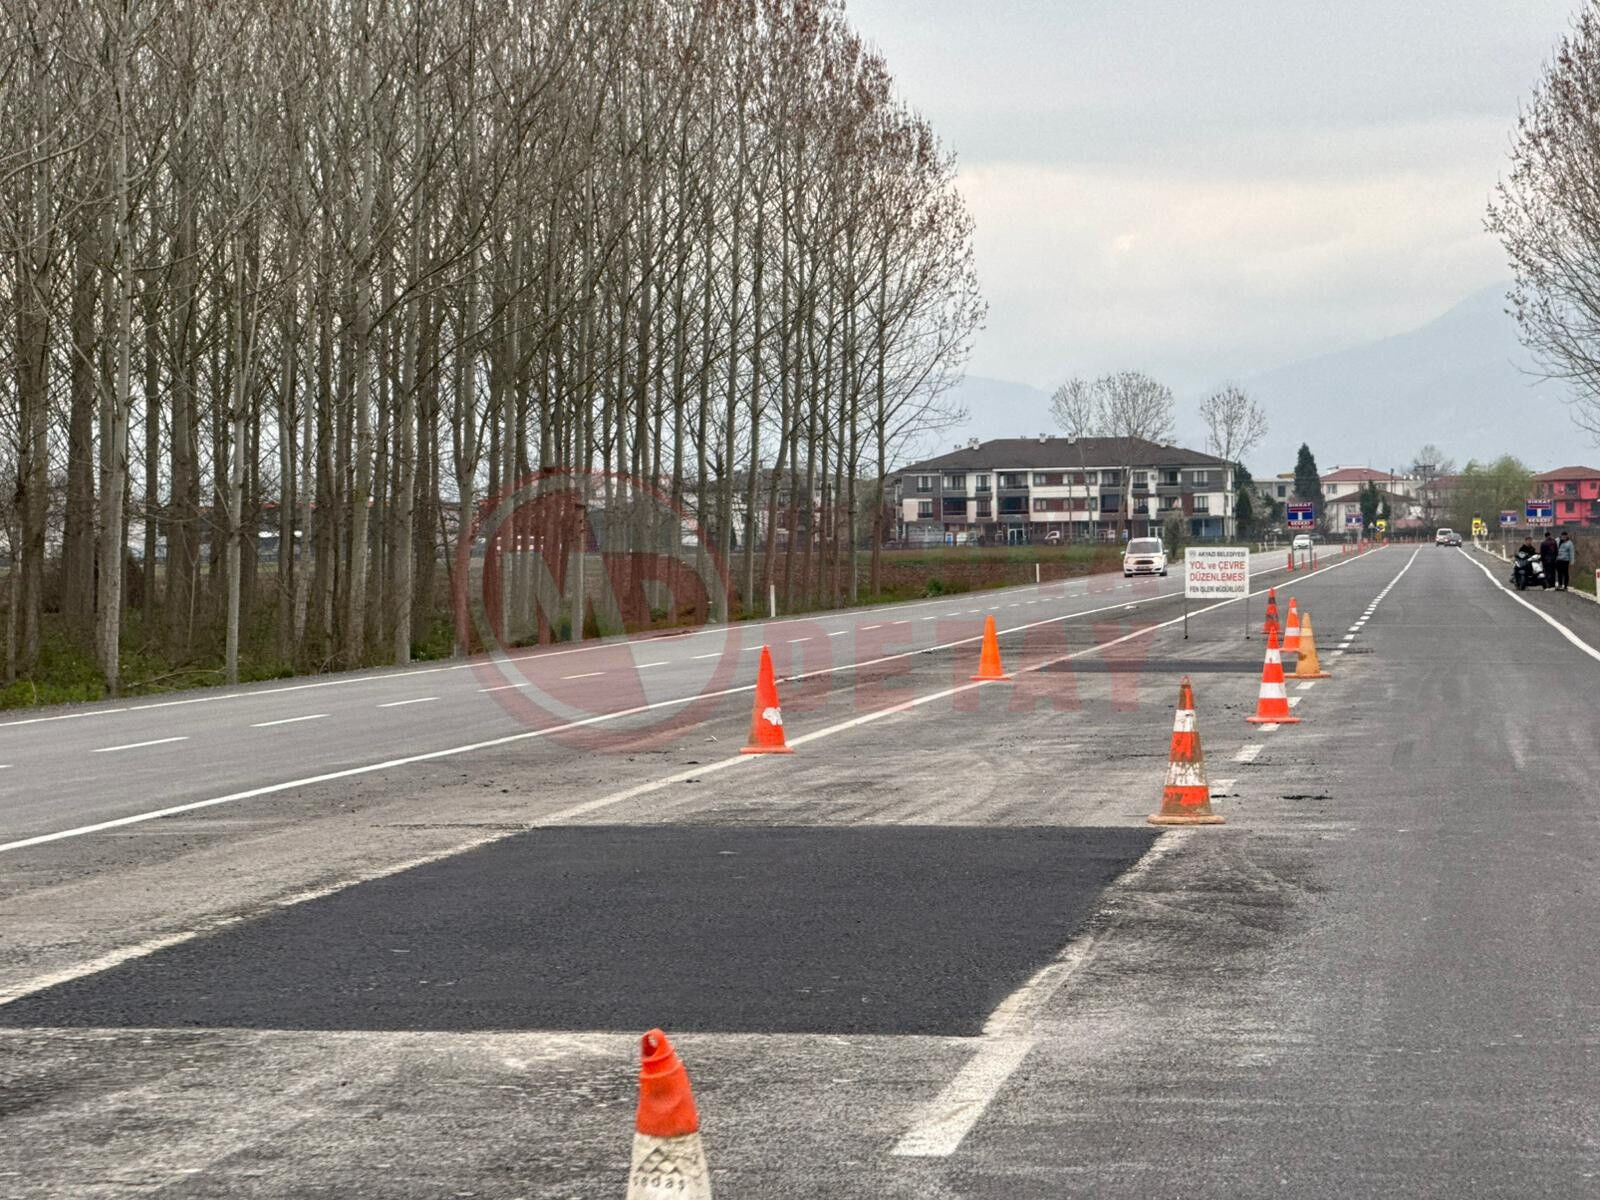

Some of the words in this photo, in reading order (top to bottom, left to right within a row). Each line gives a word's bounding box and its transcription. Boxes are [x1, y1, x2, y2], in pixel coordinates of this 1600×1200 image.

[1190, 561, 1205, 569] YOL
[1218, 561, 1246, 571] ÇEVRE
[1190, 572, 1245, 581] DÜZENLEMESİ
